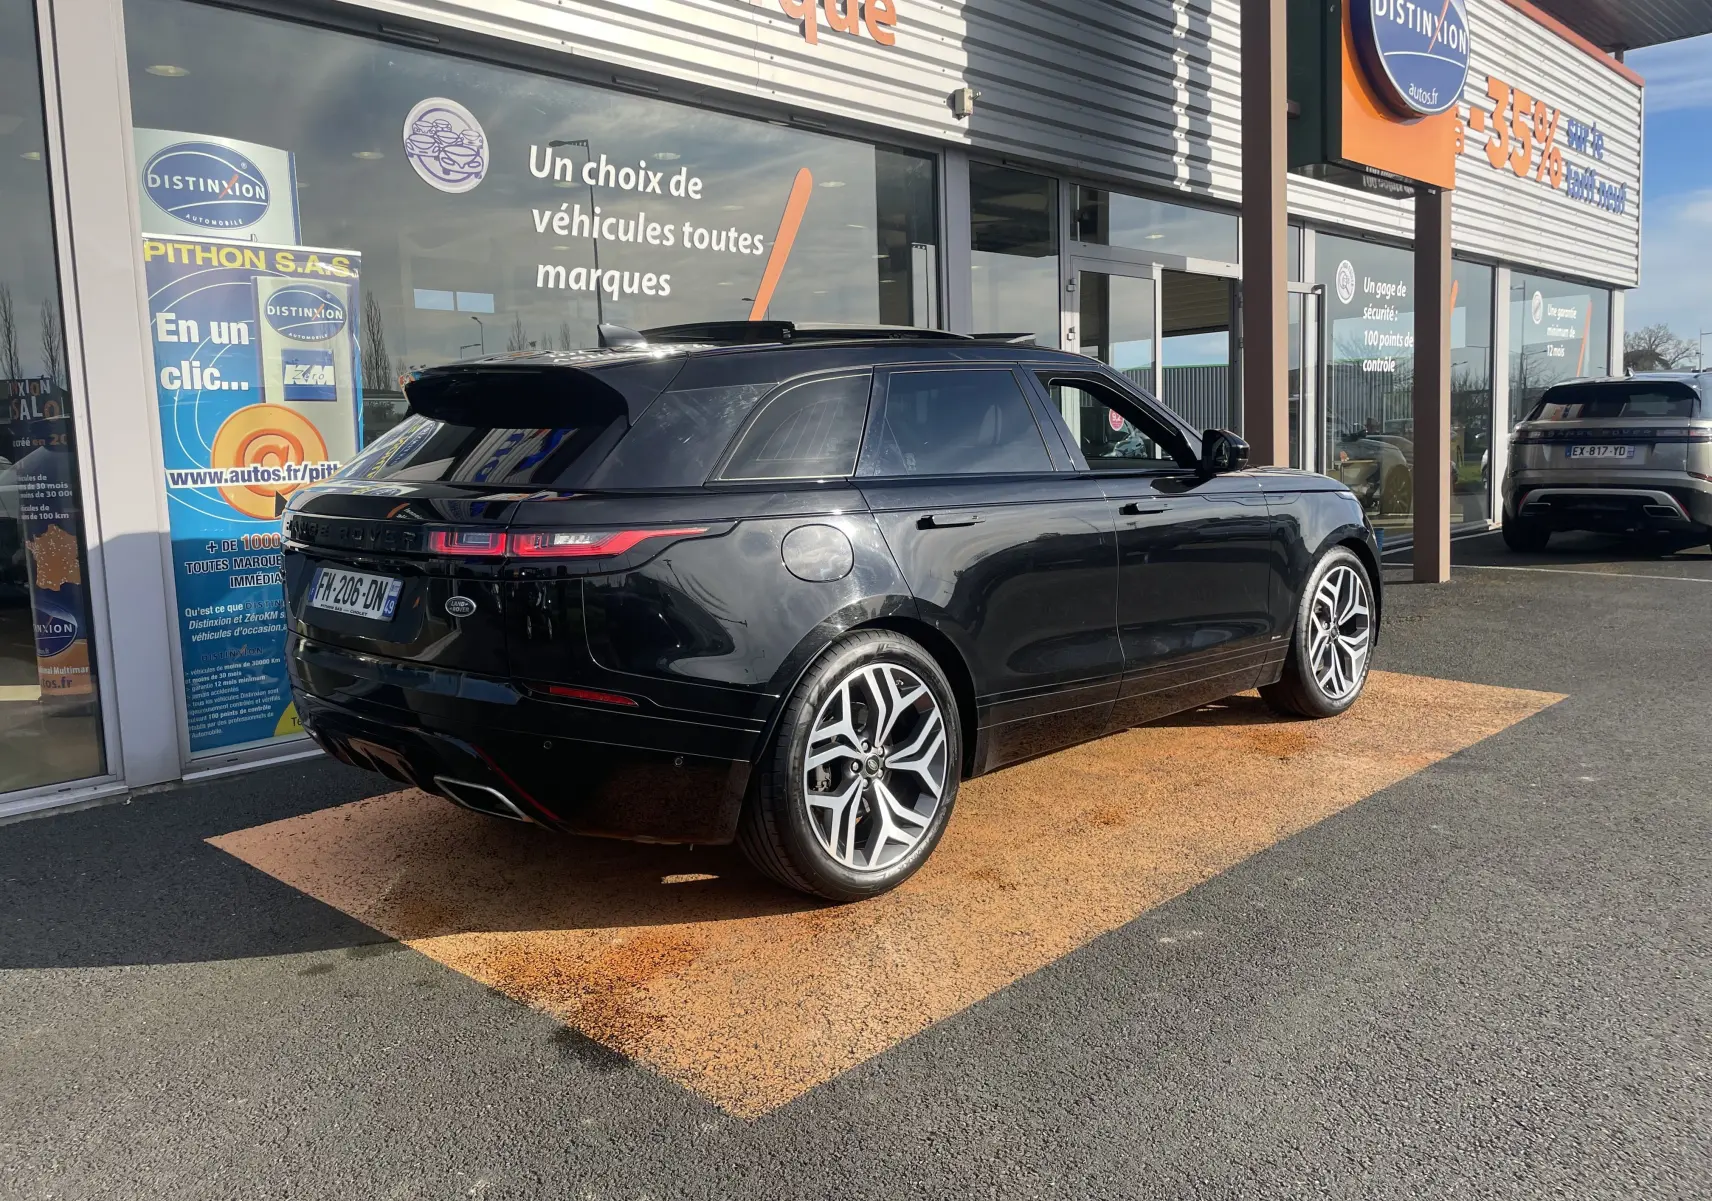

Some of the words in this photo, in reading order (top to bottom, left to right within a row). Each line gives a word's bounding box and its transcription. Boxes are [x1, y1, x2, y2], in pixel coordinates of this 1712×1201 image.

[778, 0, 897, 46] que
[1375, 0, 1466, 54] DISTINXION
[1408, 82, 1439, 105] autos.fr
[1470, 76, 1562, 189] -35%
[1566, 117, 1590, 152] sur
[1592, 121, 1605, 160] le
[528, 145, 573, 182] Un
[581, 154, 663, 194] choix
[669, 166, 703, 200] de
[147, 173, 266, 200] DISTINXION
[1566, 161, 1596, 203] tarif
[1598, 181, 1627, 215] neuf
[185, 213, 243, 227] AUTOMOBILE
[532, 202, 675, 247] véhicules
[682, 221, 764, 255] toutes
[144, 241, 266, 270] PITHON
[536, 263, 671, 301] marques
[1364, 277, 1375, 294] Un
[1376, 281, 1396, 299] gage
[1397, 280, 1407, 297] de
[267, 305, 343, 320] DISTINXION
[156, 312, 199, 343] En
[210, 320, 249, 345] un
[288, 332, 328, 340] AUTOMOBILE
[1364, 330, 1379, 346] 100
[1379, 331, 1403, 350] points
[1404, 332, 1414, 348] de
[1547, 344, 1553, 357] 12
[1363, 355, 1396, 373] contrôle
[160, 360, 249, 390] clic...
[284, 364, 335, 385] KM
[1572, 446, 1626, 456] EX-817-YD
[46, 490, 57, 498] 30
[47, 481, 69, 489] mois
[222, 540, 237, 553] DE
[185, 559, 229, 574] TOUTES
[185, 607, 213, 617] Qu'est
[215, 606, 225, 614] ce
[227, 604, 243, 613] que
[383, 600, 395, 615] 49
[189, 617, 231, 630] Distinxion
[233, 615, 243, 624] et
[245, 611, 278, 623] ZéroKM
[192, 629, 232, 642] véhicules
[234, 624, 281, 636] d'occasion
